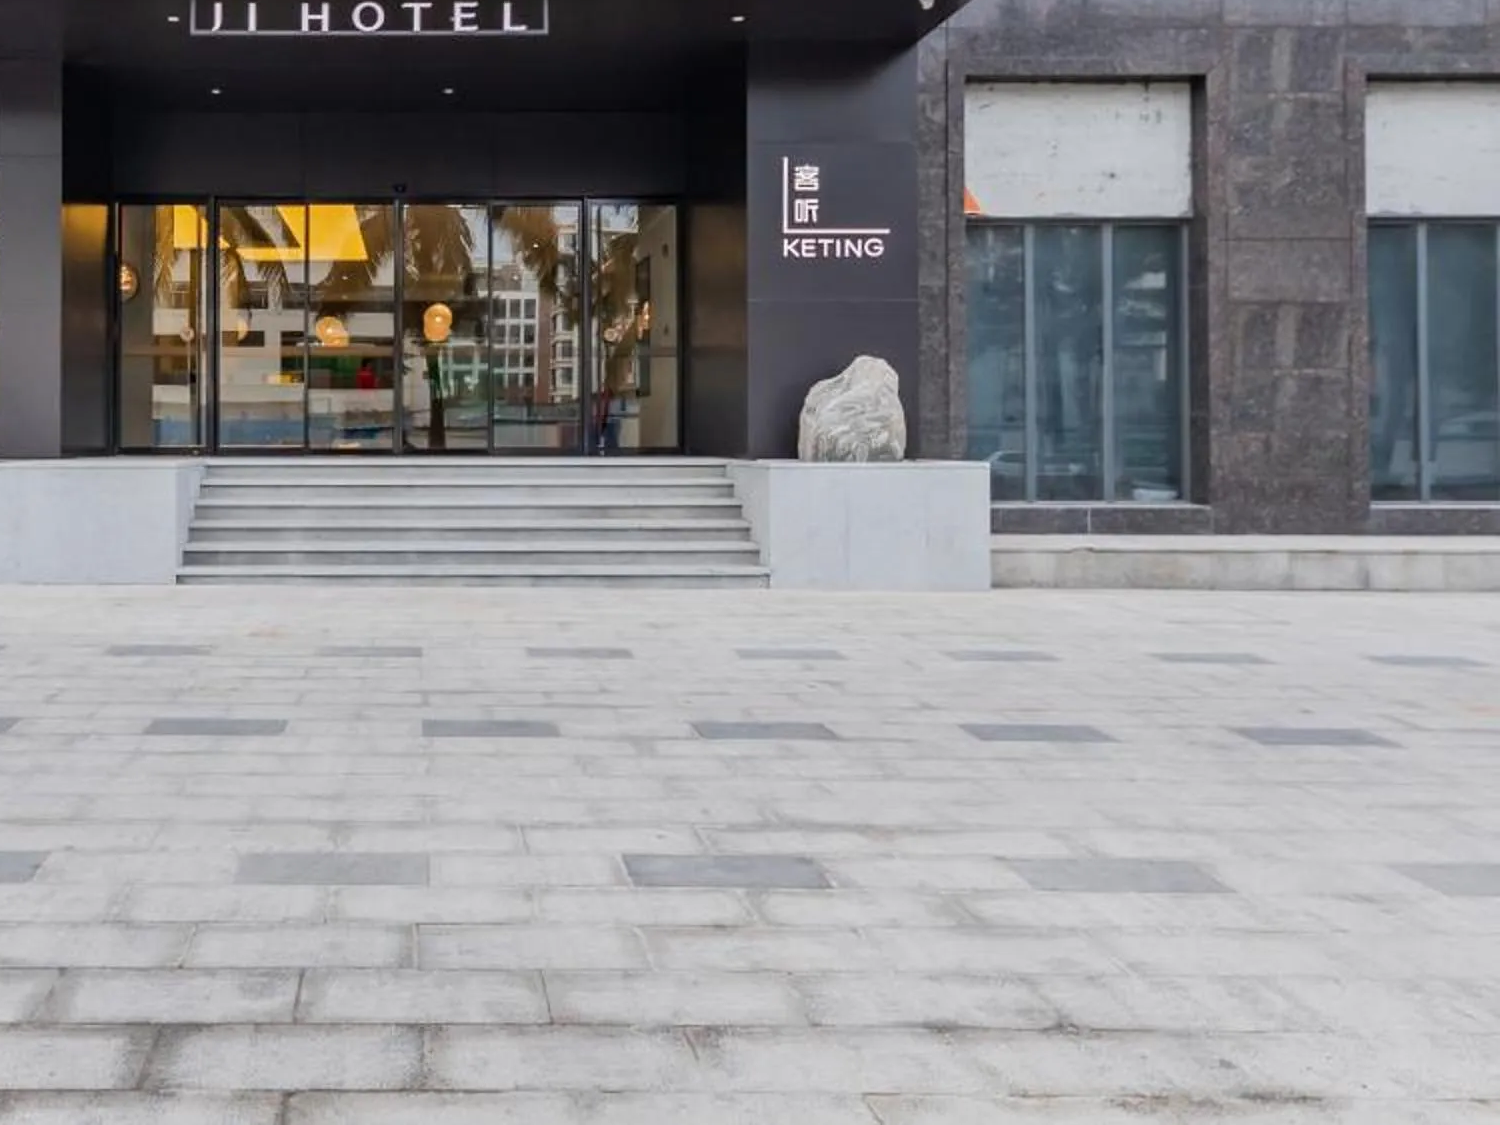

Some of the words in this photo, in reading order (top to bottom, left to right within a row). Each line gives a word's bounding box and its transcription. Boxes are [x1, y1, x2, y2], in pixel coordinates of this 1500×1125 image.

[210, 1, 257, 32] JI
[300, 1, 528, 32] HOTEL
[783, 237, 885, 258] KETING
